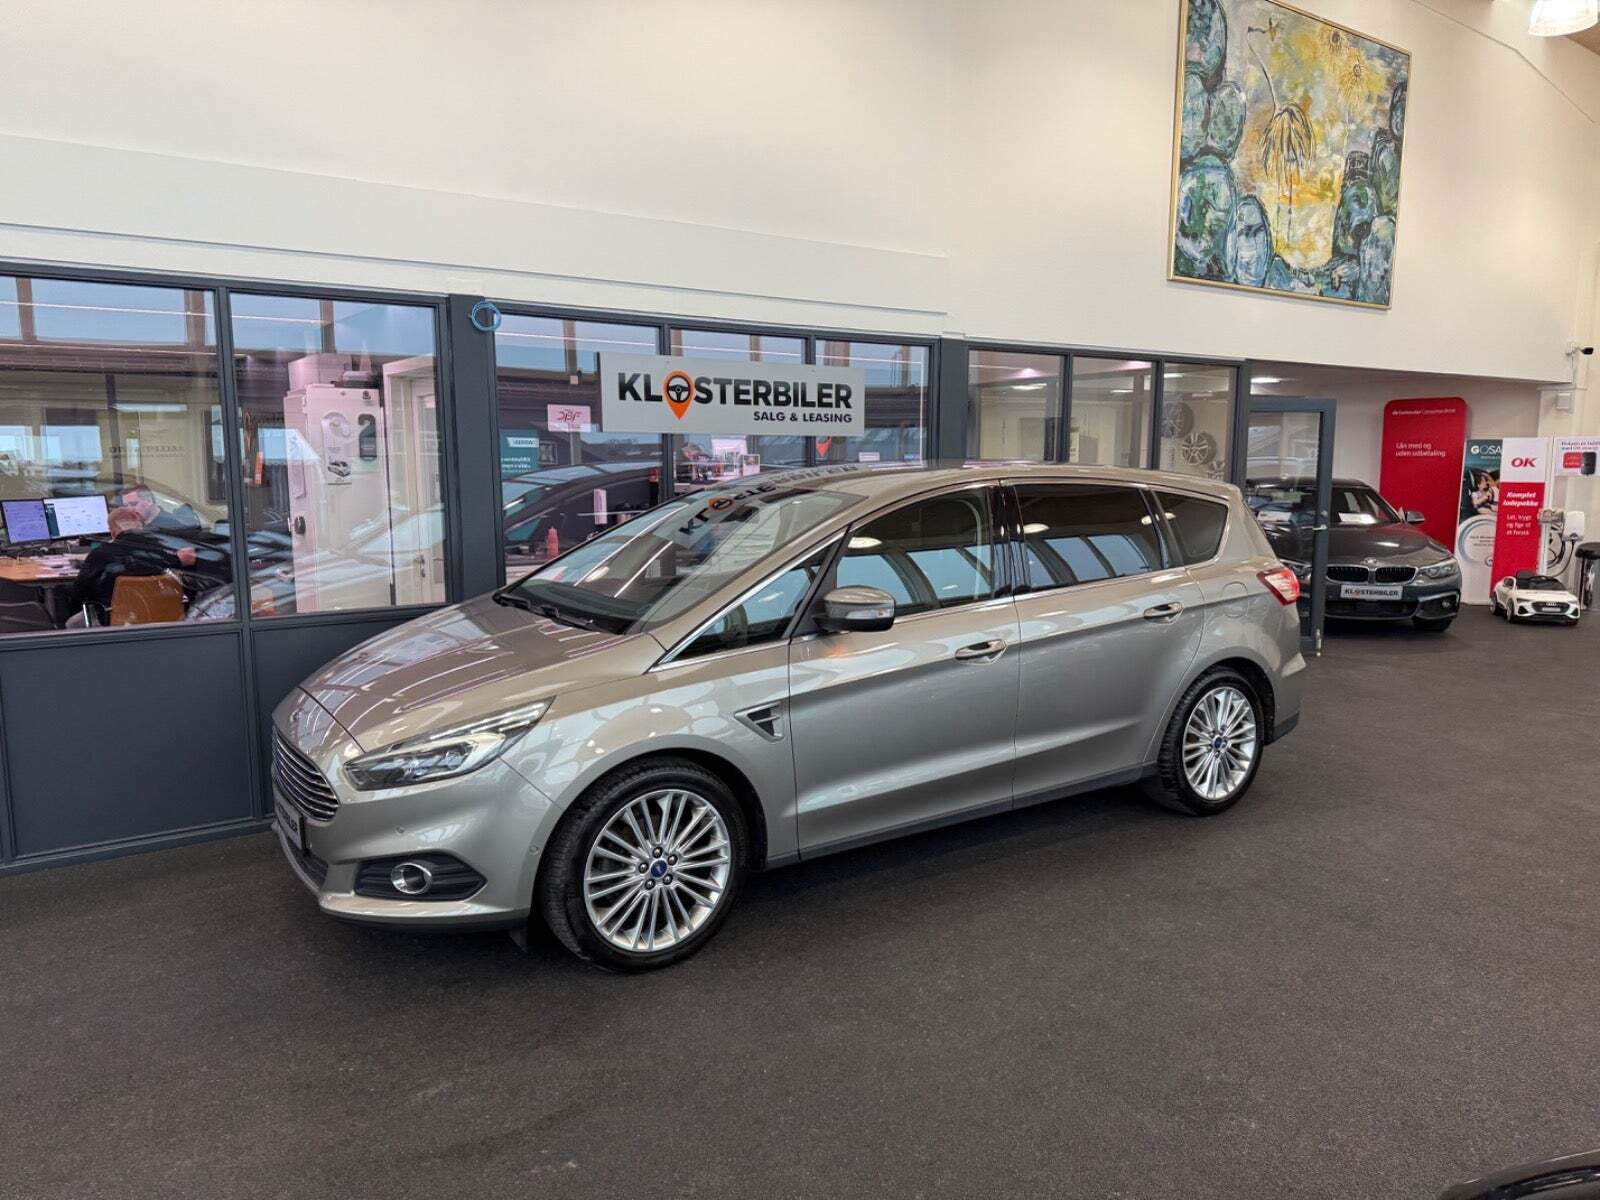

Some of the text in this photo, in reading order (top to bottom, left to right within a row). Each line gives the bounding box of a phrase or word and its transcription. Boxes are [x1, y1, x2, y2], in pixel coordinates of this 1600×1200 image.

[618, 370, 853, 409] KLOSTERBILER
[753, 411, 853, 424] SALG & LEASING
[1511, 457, 1538, 468] OK
